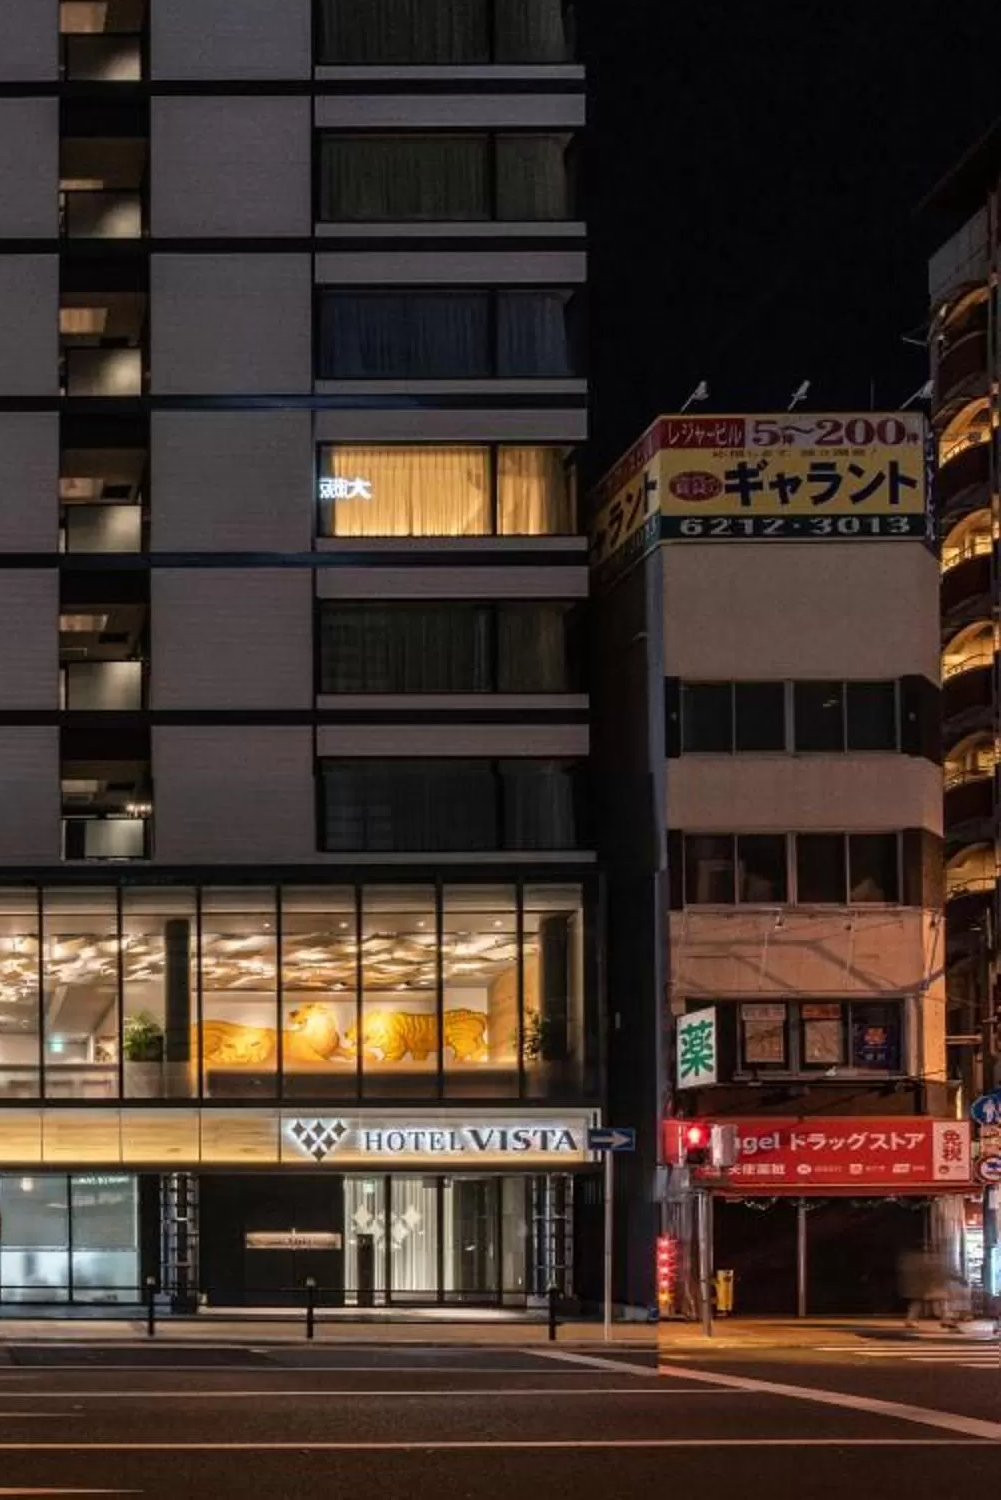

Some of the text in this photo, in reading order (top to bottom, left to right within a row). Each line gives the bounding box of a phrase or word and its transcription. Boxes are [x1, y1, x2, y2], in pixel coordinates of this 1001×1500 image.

[724, 459, 918, 506] ギャラント
[680, 1020, 715, 1078] 薬
[364, 1129, 578, 1151] HOTEL VISTA
[790, 1131, 925, 1152] ドラッグストア
